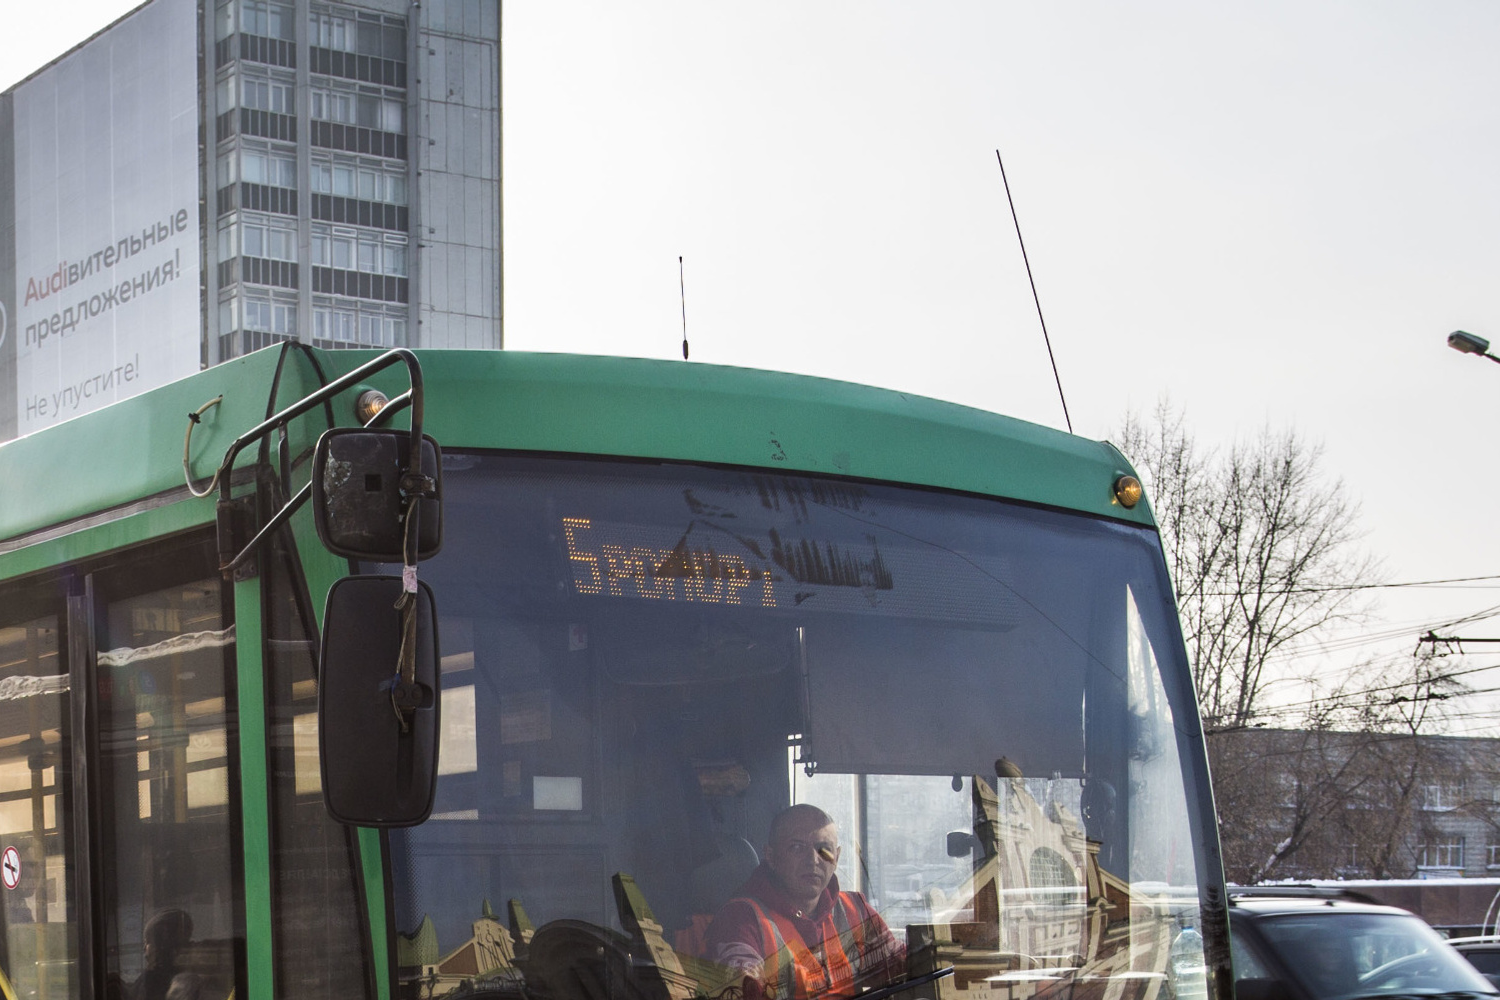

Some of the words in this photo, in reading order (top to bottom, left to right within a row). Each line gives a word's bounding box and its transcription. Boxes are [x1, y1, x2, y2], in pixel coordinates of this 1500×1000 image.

[24, 208, 188, 306] Audiвительные
[25, 248, 181, 348] предложения!
[26, 397, 47, 421] Не
[52, 353, 140, 418] упустите!
[562, 517, 602, 594] 5
